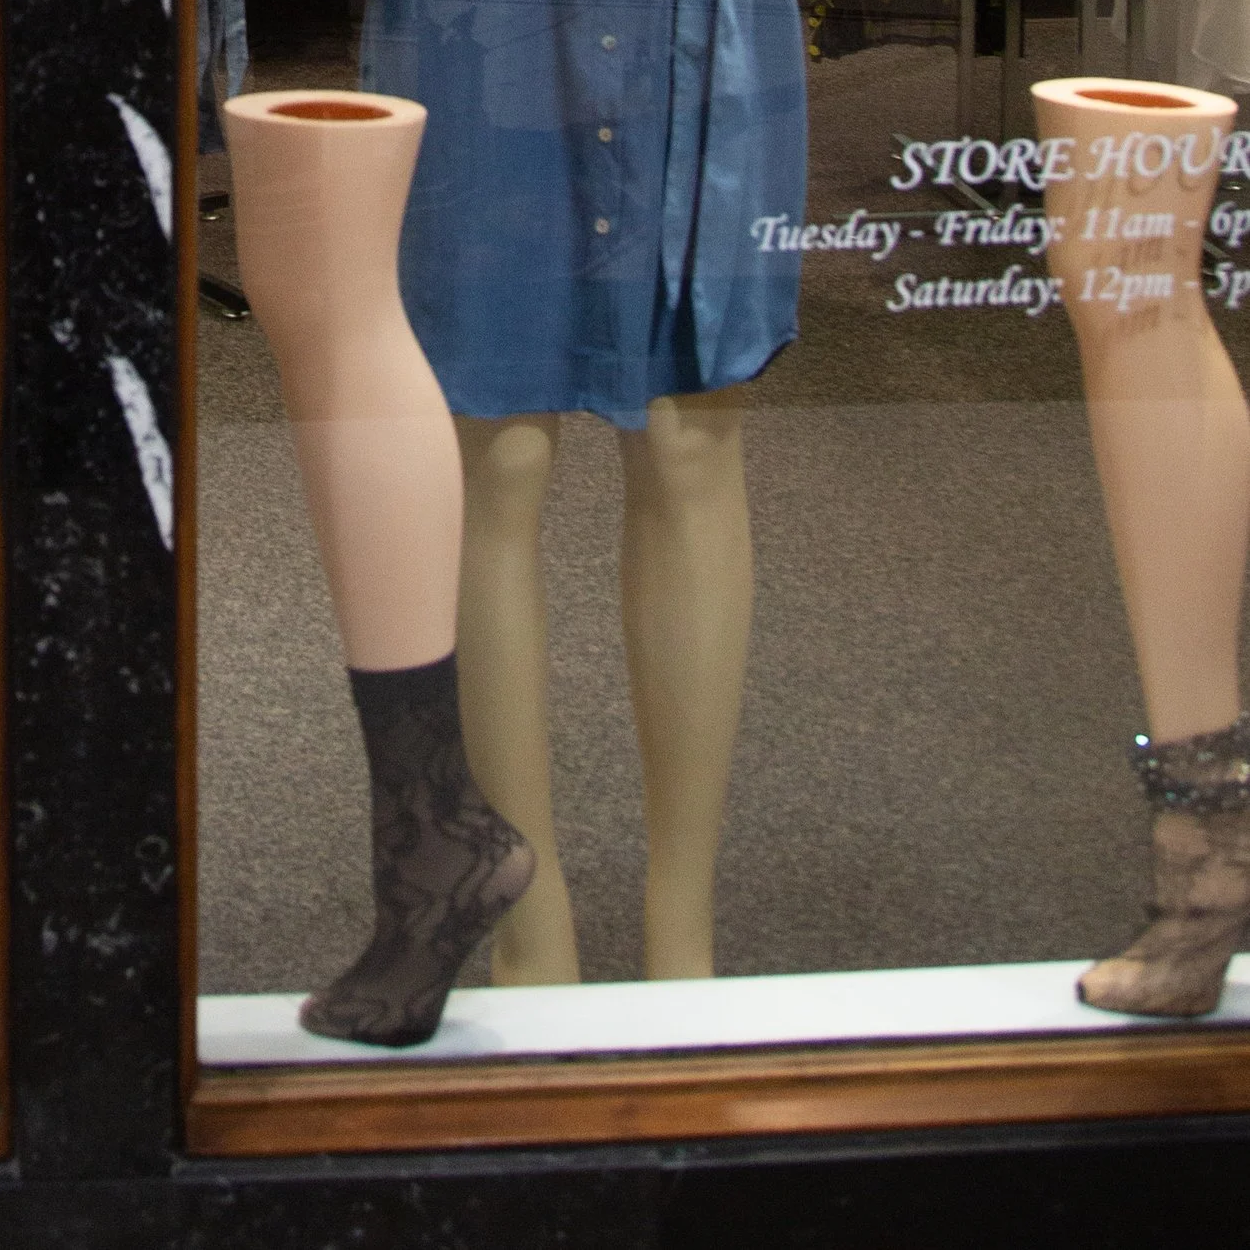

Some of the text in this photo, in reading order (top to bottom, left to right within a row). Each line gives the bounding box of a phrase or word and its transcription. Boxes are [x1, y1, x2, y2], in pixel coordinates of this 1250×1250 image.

[890, 136, 1076, 189] STORE
[750, 209, 900, 261] Tuesday
[935, 204, 1065, 254] Friday:
[1081, 206, 1175, 240] 11am
[886, 265, 1064, 316] Saturday:
[1079, 266, 1175, 313] 12pm
